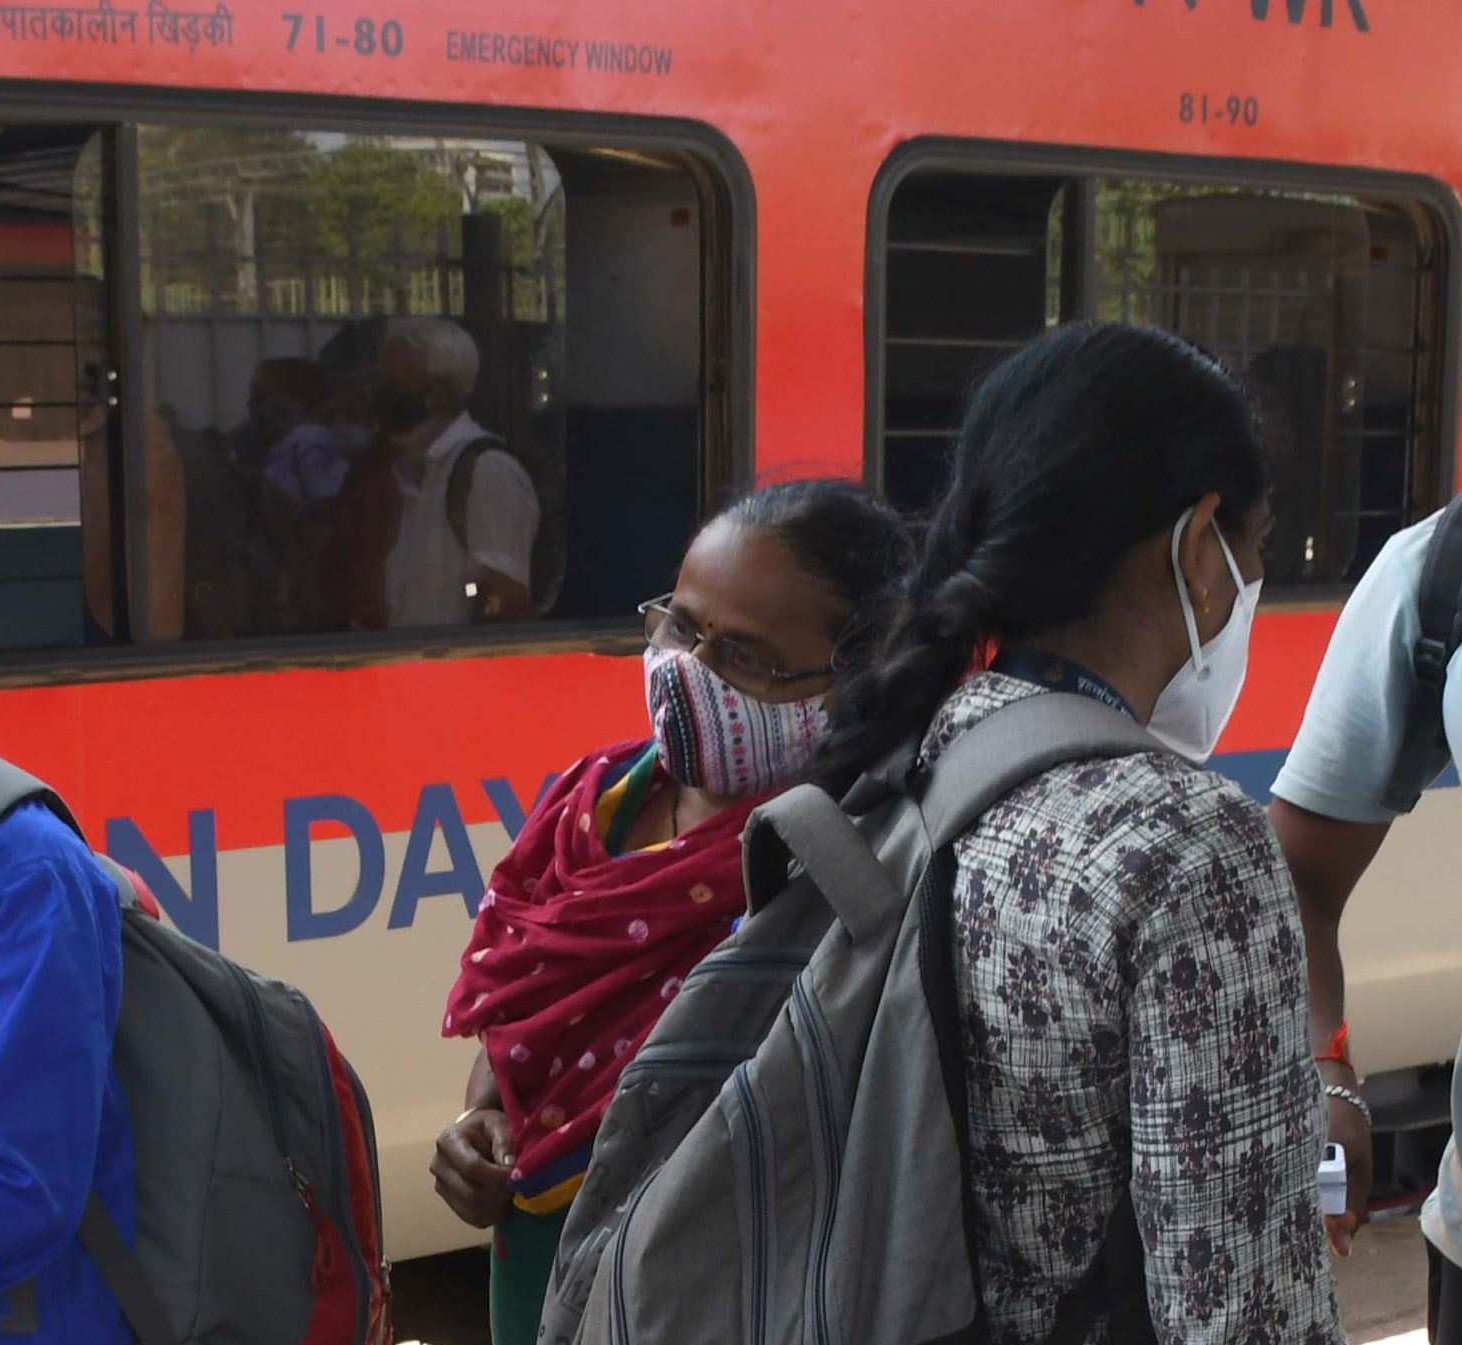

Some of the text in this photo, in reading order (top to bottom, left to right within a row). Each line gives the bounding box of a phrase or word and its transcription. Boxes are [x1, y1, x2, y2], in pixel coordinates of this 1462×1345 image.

[148, 4, 234, 52] खिड़की
[281, 12, 404, 57] 71-80
[446, 29, 672, 76] EMERGENCY WINDOW
[1179, 92, 1258, 126] 81-90
